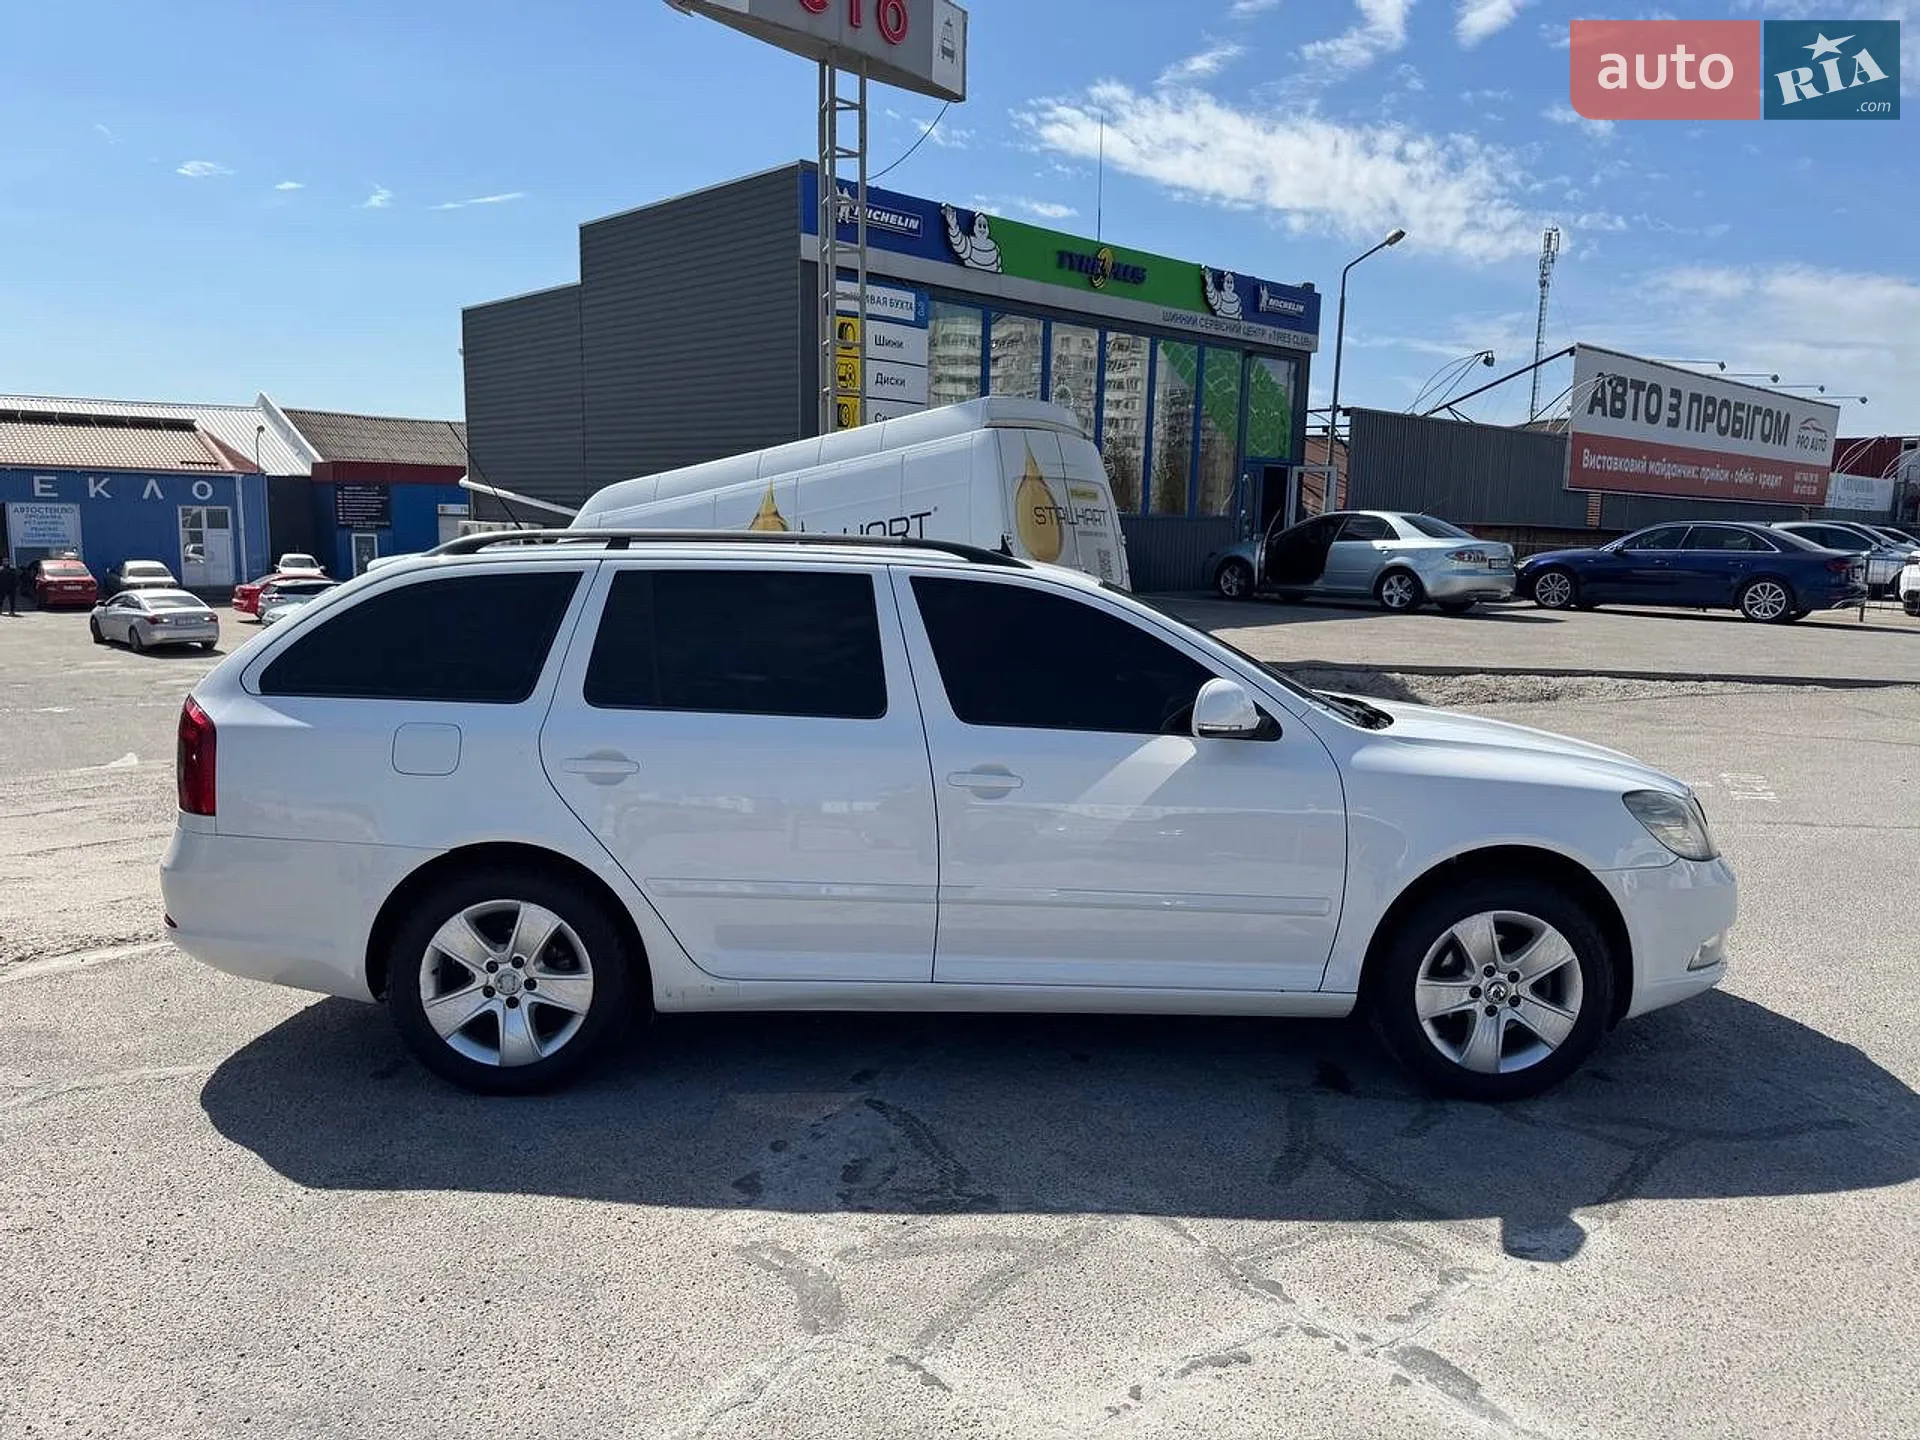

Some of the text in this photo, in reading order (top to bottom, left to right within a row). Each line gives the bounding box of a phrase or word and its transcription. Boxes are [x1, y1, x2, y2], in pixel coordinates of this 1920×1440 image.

[874, 334, 904, 349] Шини
[874, 372, 906, 387] Диски
[1587, 371, 1662, 425] АВТО
[1685, 392, 1792, 447] ПРОБІГОМ
[1582, 448, 1647, 474] Виставковий
